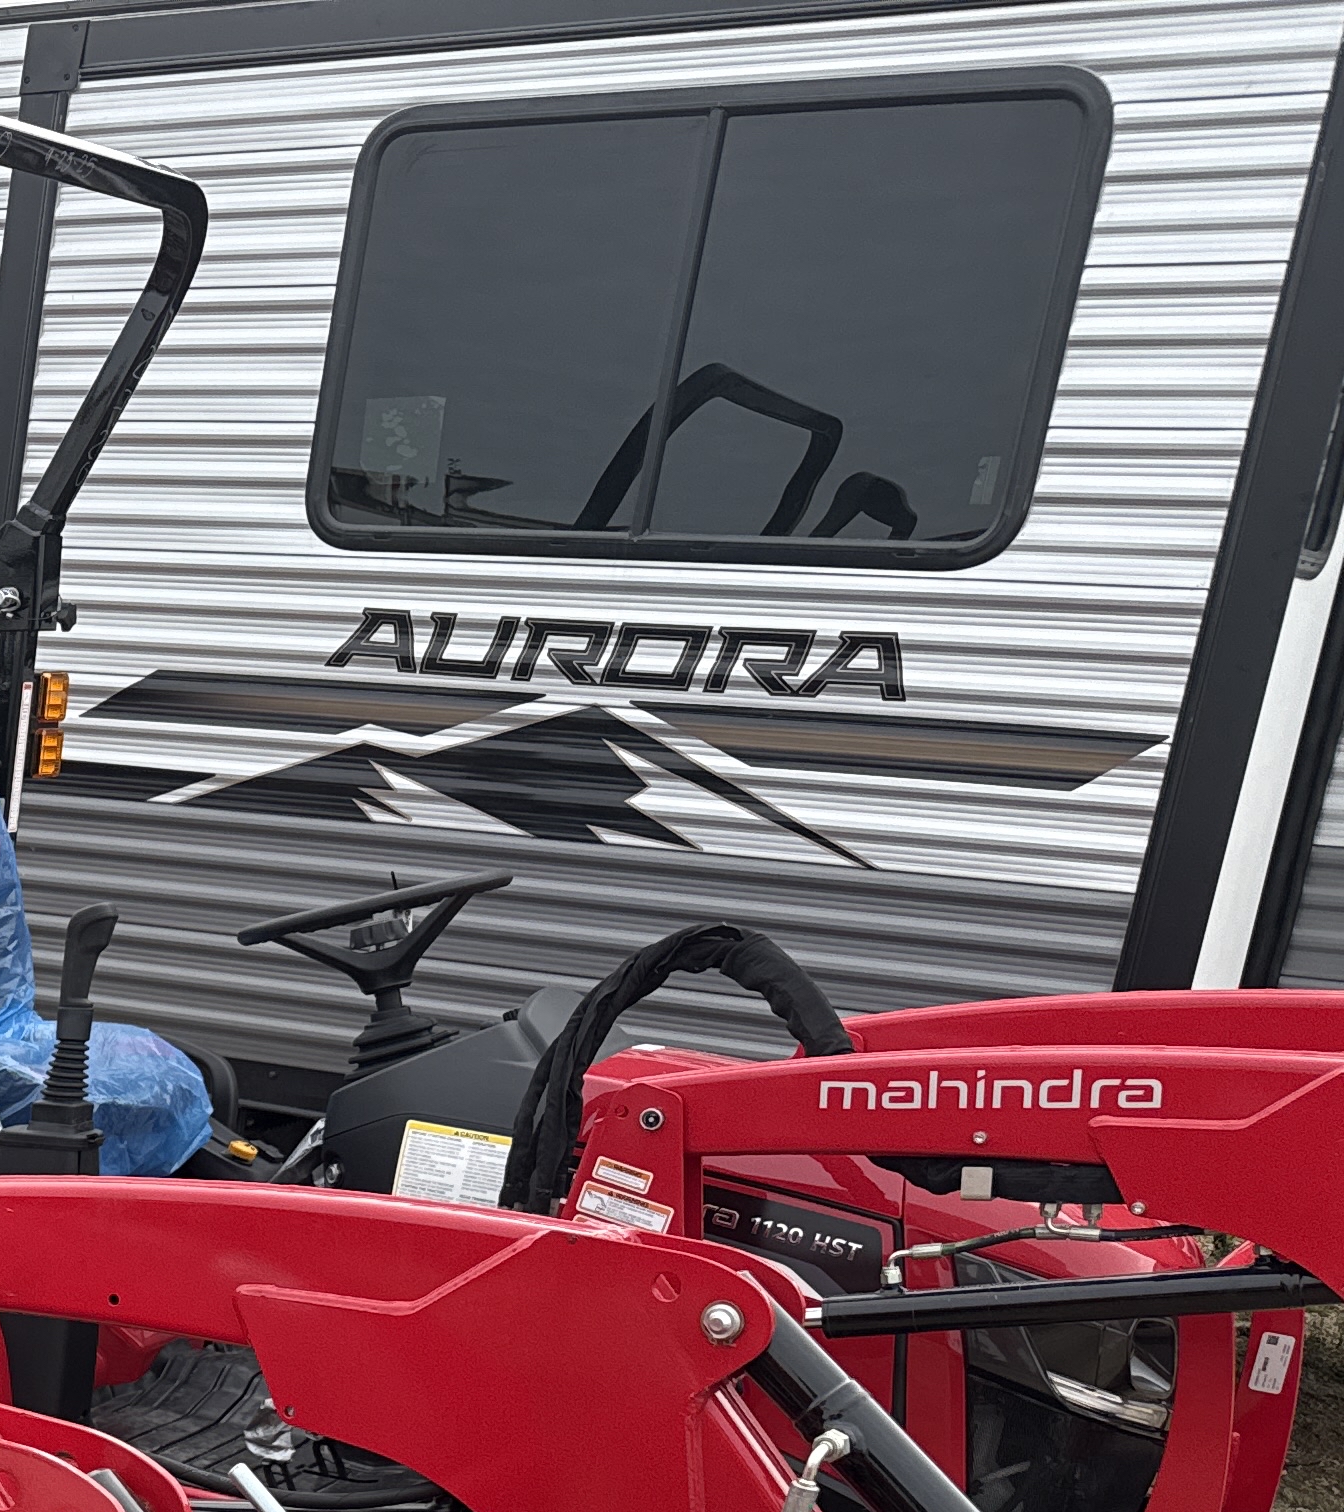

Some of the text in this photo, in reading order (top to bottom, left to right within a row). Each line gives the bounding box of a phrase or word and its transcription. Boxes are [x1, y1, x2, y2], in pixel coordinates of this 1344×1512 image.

[324, 607, 907, 702] AURORA
[819, 1069, 1163, 1110] mahindra
[460, 1131, 490, 1142] CAUTION
[750, 1217, 804, 1246] 1120
[811, 1232, 864, 1262] HST
